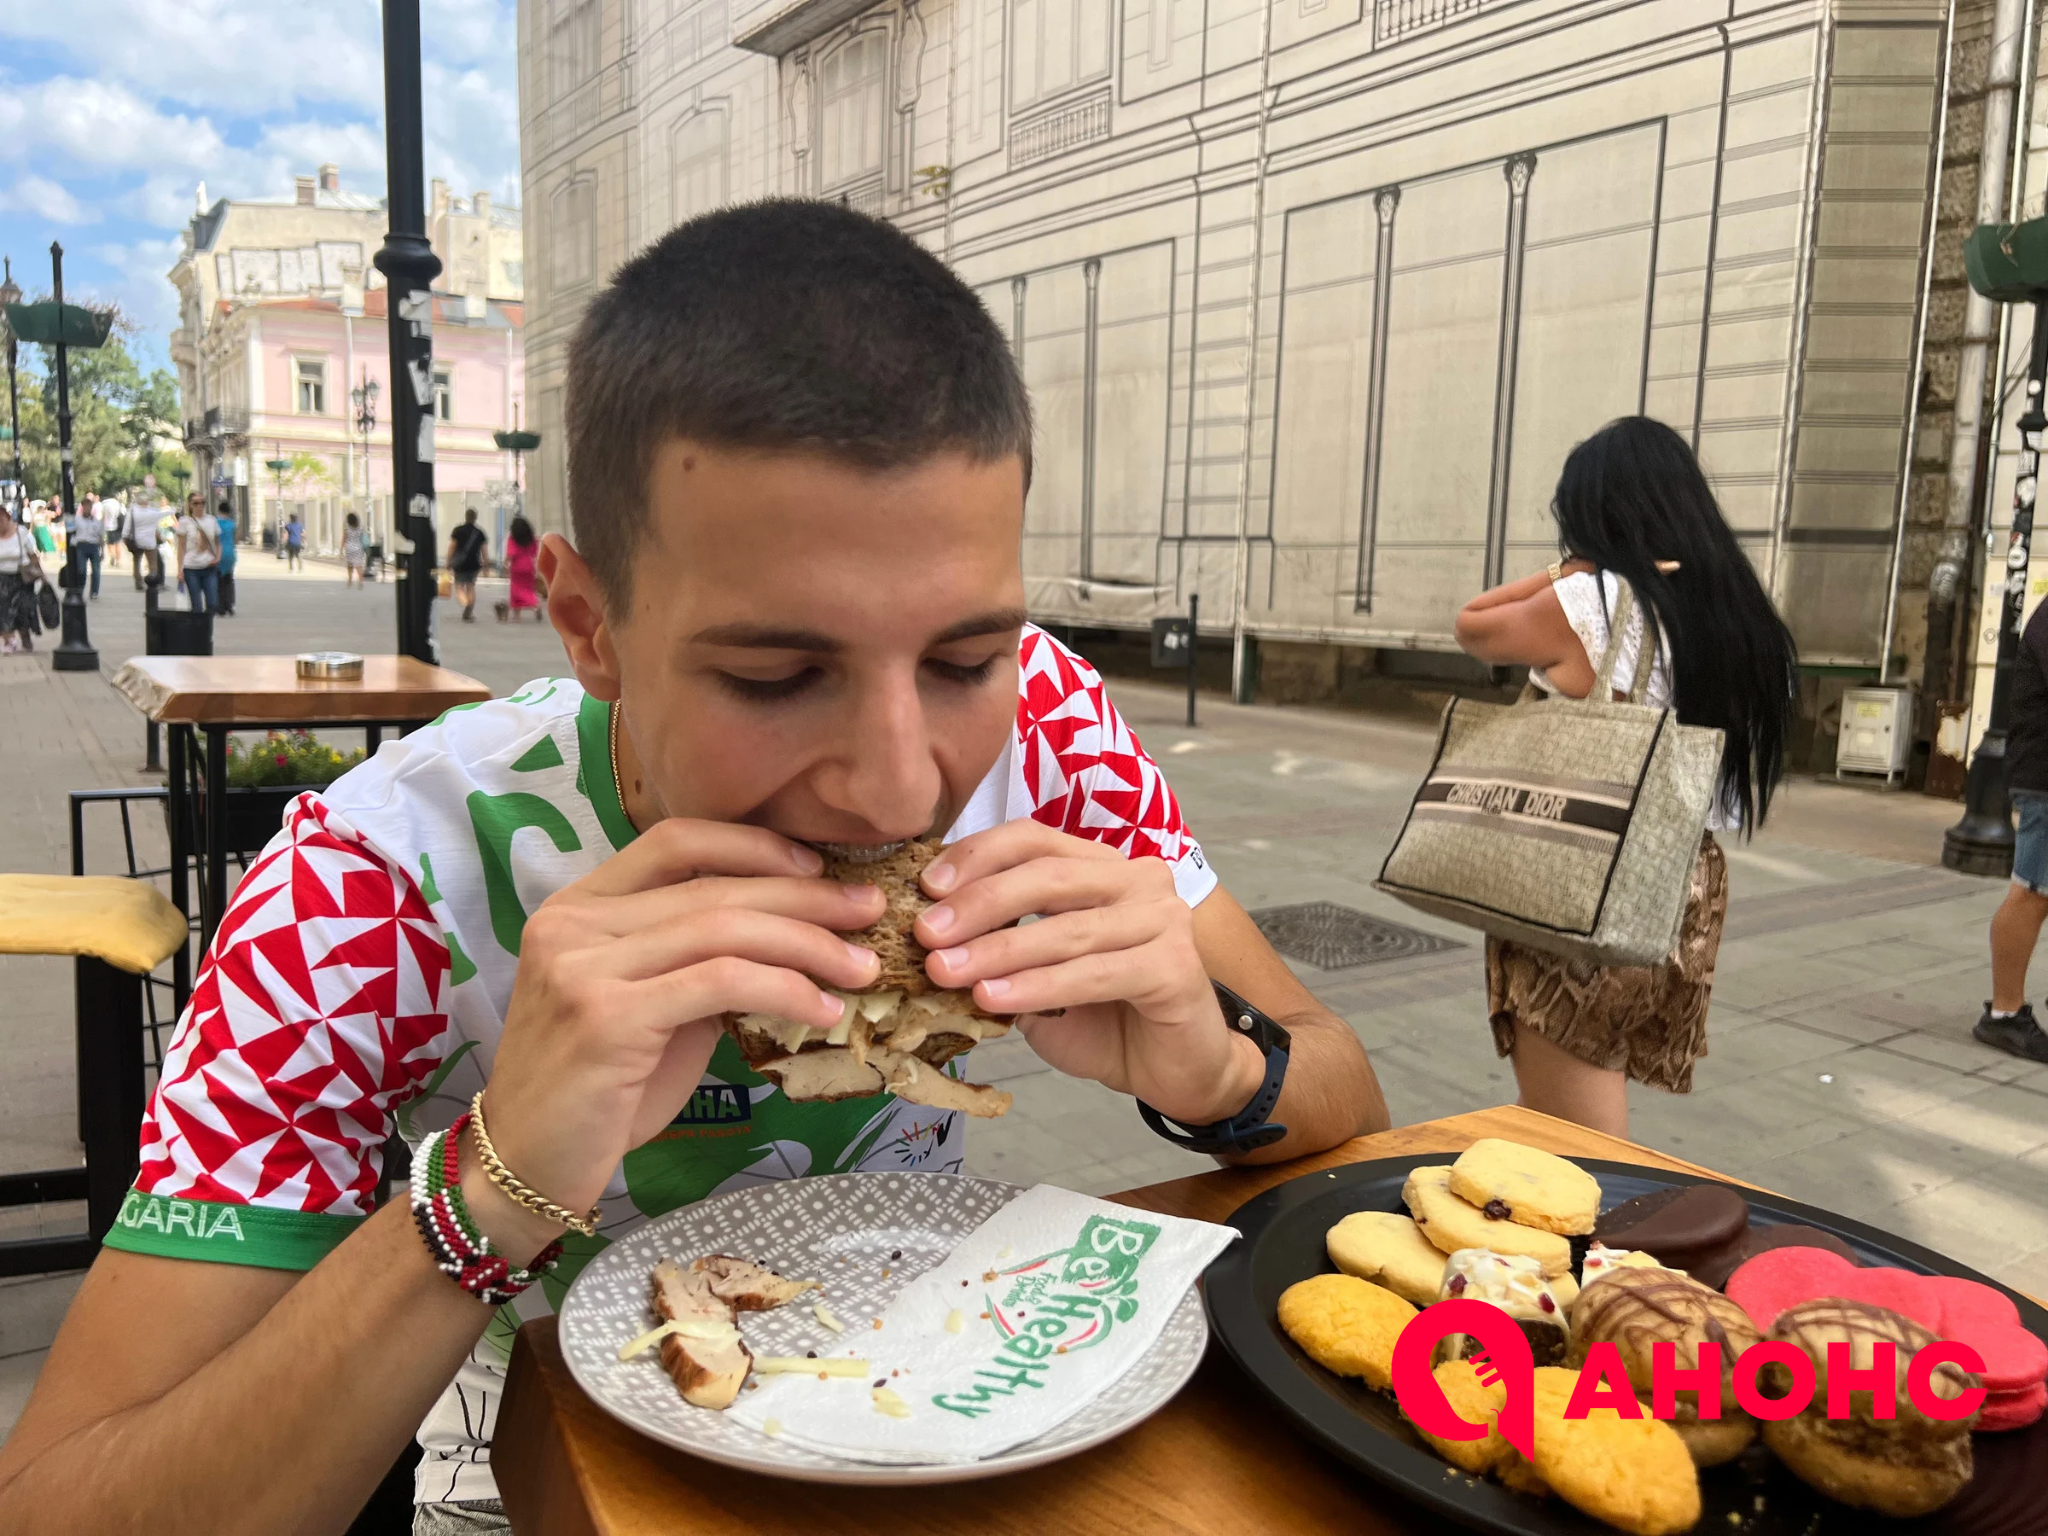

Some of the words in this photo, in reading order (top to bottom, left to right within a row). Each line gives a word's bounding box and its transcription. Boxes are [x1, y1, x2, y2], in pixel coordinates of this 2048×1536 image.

[1446, 783, 1518, 811] CHRISTIAN
[1523, 790, 1567, 819] DIOR
[116, 1193, 245, 1241] GARIA
[1069, 1222, 1146, 1277] Be
[931, 1294, 1104, 1419] Healthy
